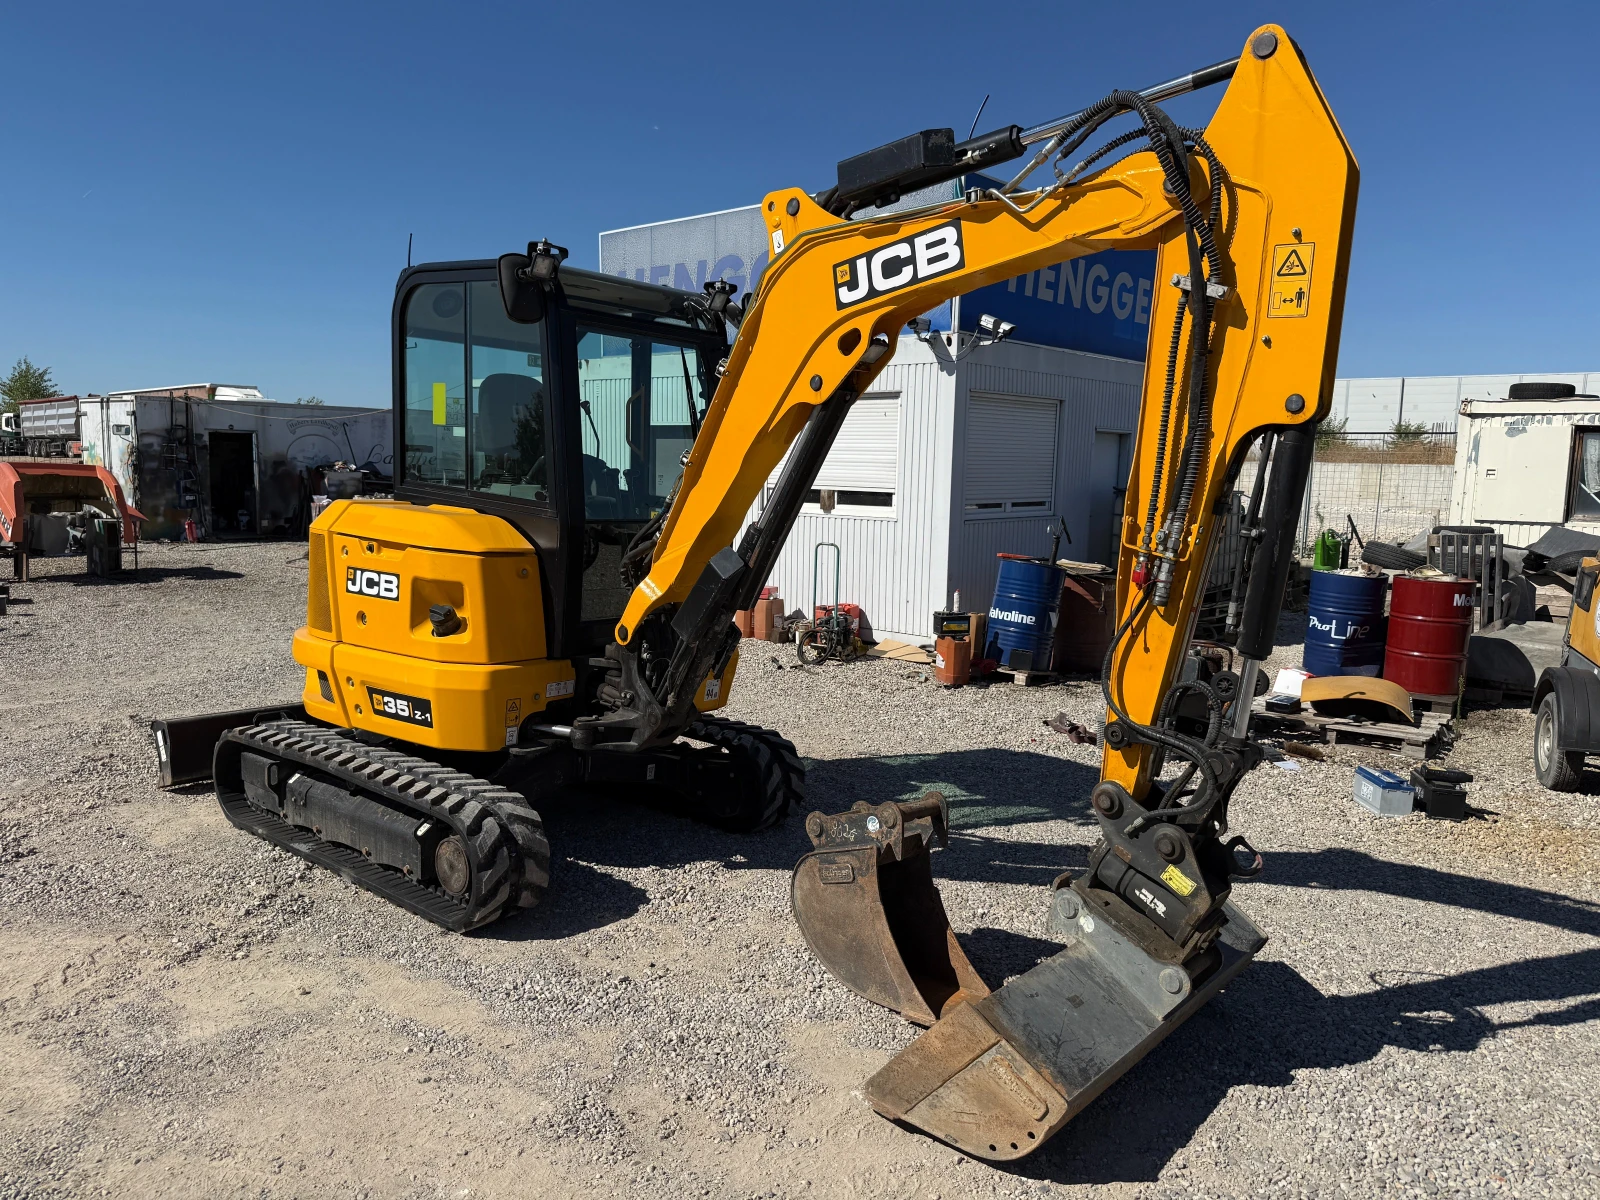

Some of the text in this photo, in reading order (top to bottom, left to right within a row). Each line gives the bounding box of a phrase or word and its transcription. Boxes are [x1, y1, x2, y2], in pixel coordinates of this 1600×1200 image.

[838, 226, 961, 304] JCB
[347, 570, 399, 599] JCB
[383, 696, 410, 717] 35
